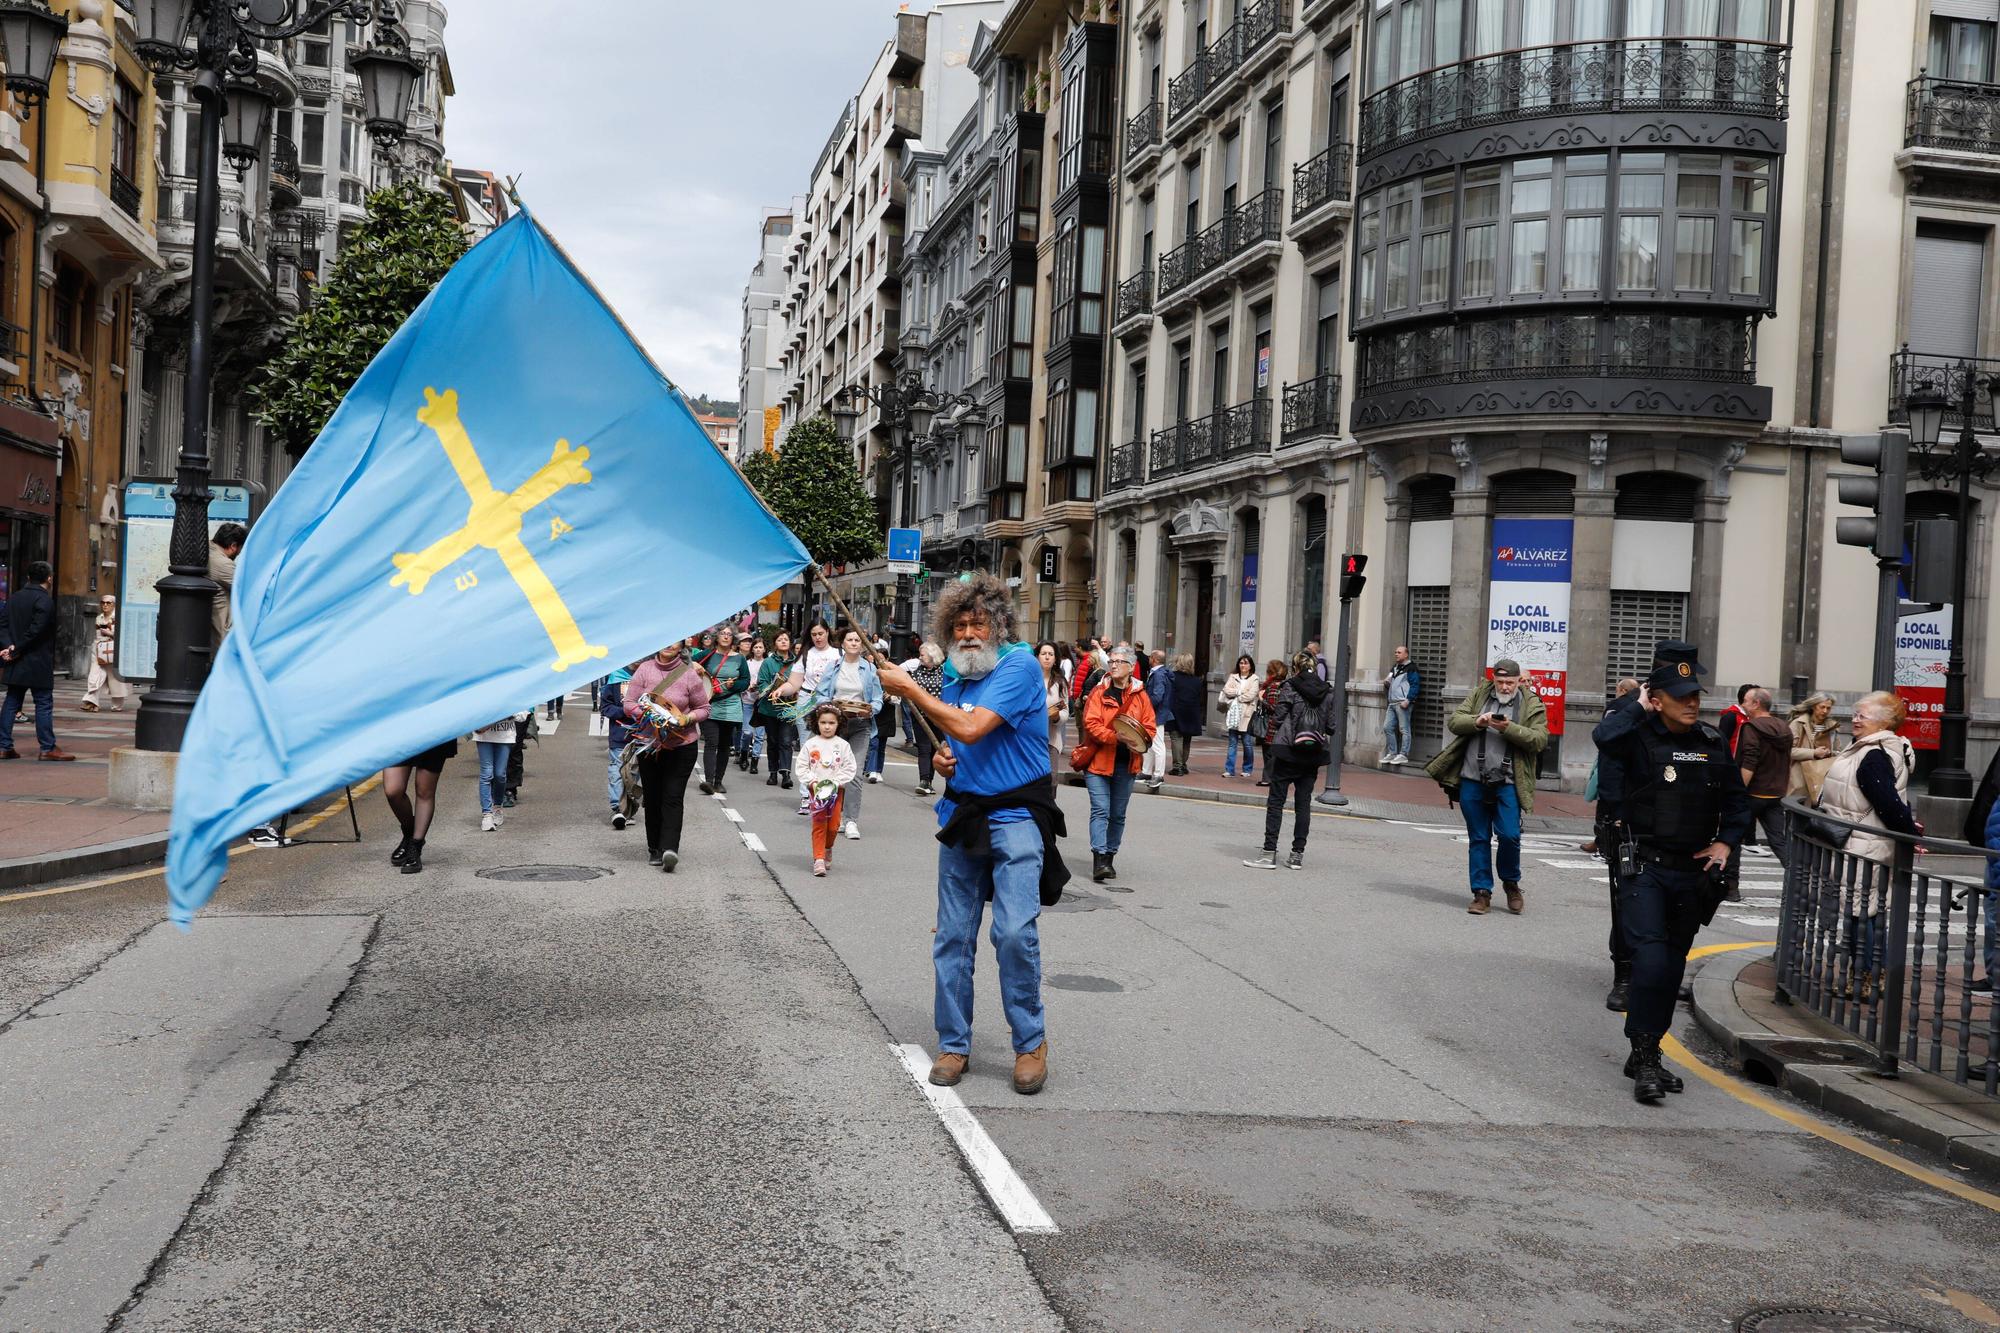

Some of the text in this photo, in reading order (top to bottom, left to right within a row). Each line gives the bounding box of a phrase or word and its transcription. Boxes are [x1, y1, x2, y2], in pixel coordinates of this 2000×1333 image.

[1514, 550, 1567, 561] ALVAREZ
[1508, 604, 1550, 617] LOCAL
[1490, 619, 1566, 633] DISPONIBLE
[1904, 622, 1940, 635] LOCAL
[1896, 637, 1952, 650] ISPONIBLE
[1540, 687, 1562, 697] 089
